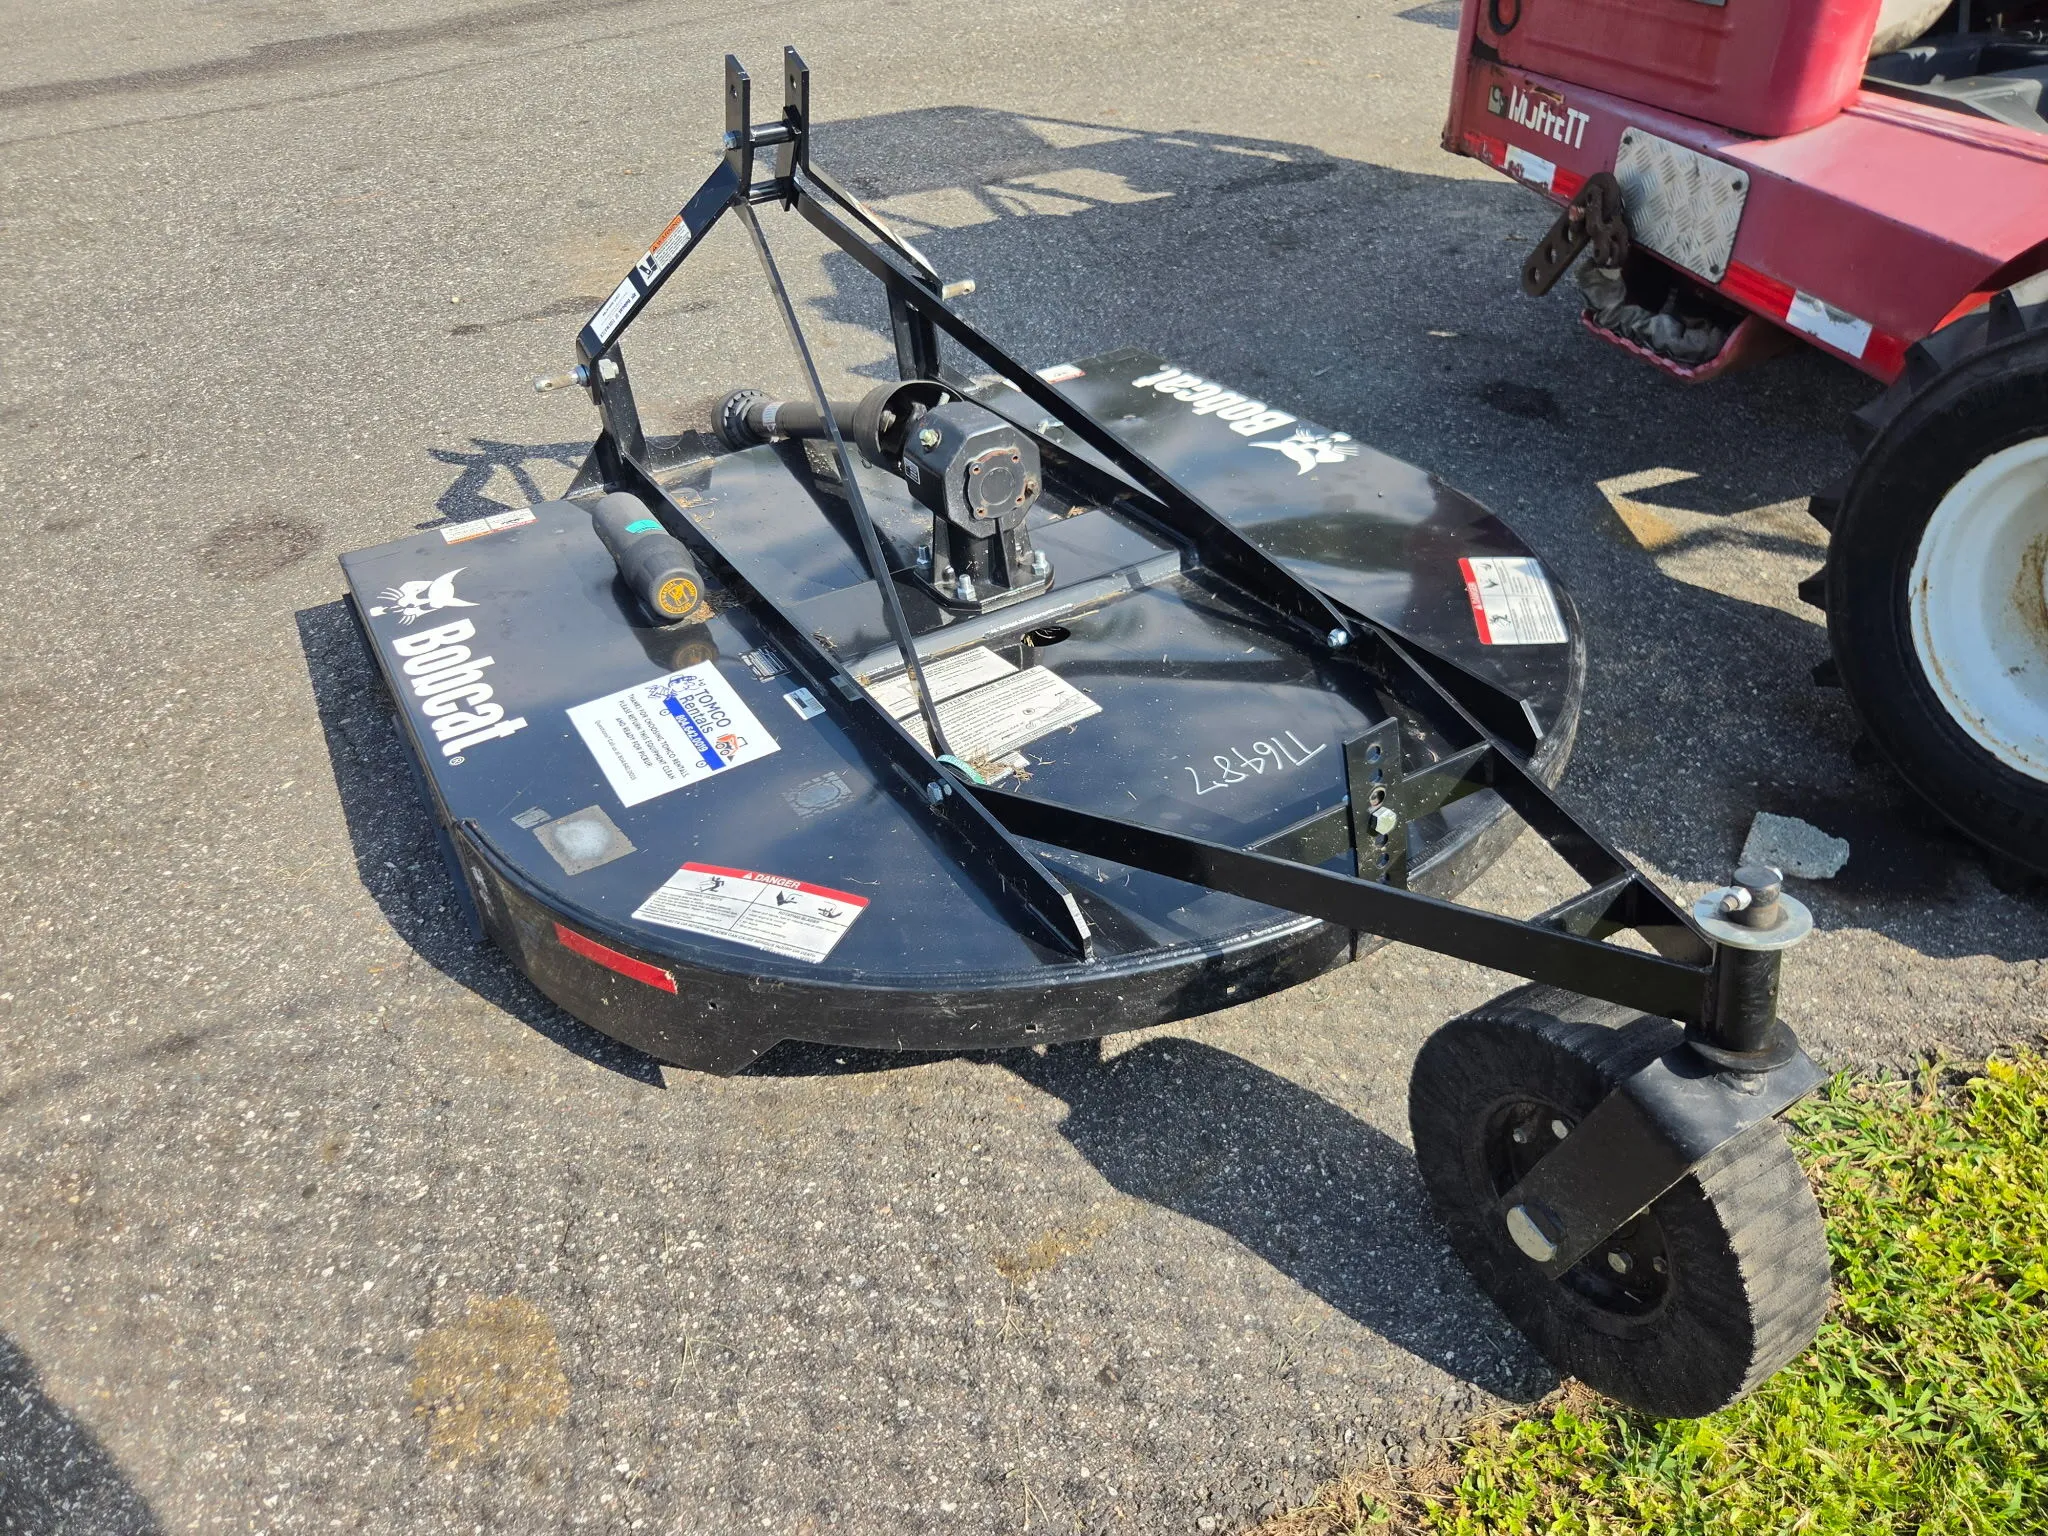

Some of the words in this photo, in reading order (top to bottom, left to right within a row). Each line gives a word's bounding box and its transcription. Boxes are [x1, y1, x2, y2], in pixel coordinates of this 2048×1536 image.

[1131, 366, 1298, 436] Bobcat
[393, 618, 528, 756] Bobcat
[965, 684, 998, 699] SERVICE
[996, 668, 1037, 686] SCHEDULE
[627, 693, 643, 709] THANKS
[637, 708, 649, 718] FOR
[643, 717, 665, 741] CHOOSING
[659, 741, 676, 758] TOMCO
[678, 694, 718, 734] Rentals
[692, 688, 733, 729] TOMCO
[614, 716, 626, 727] AND
[621, 726, 636, 741] READY
[630, 740, 642, 751] FOR
[617, 699, 632, 714] PLEASE
[626, 713, 643, 731] RETURN
[637, 730, 649, 740] THIS
[644, 739, 666, 765] EQUIPMENT
[661, 765, 676, 780] CLEAN
[674, 713, 709, 752] 804.642.0019
[753, 873, 802, 889] DANGER
